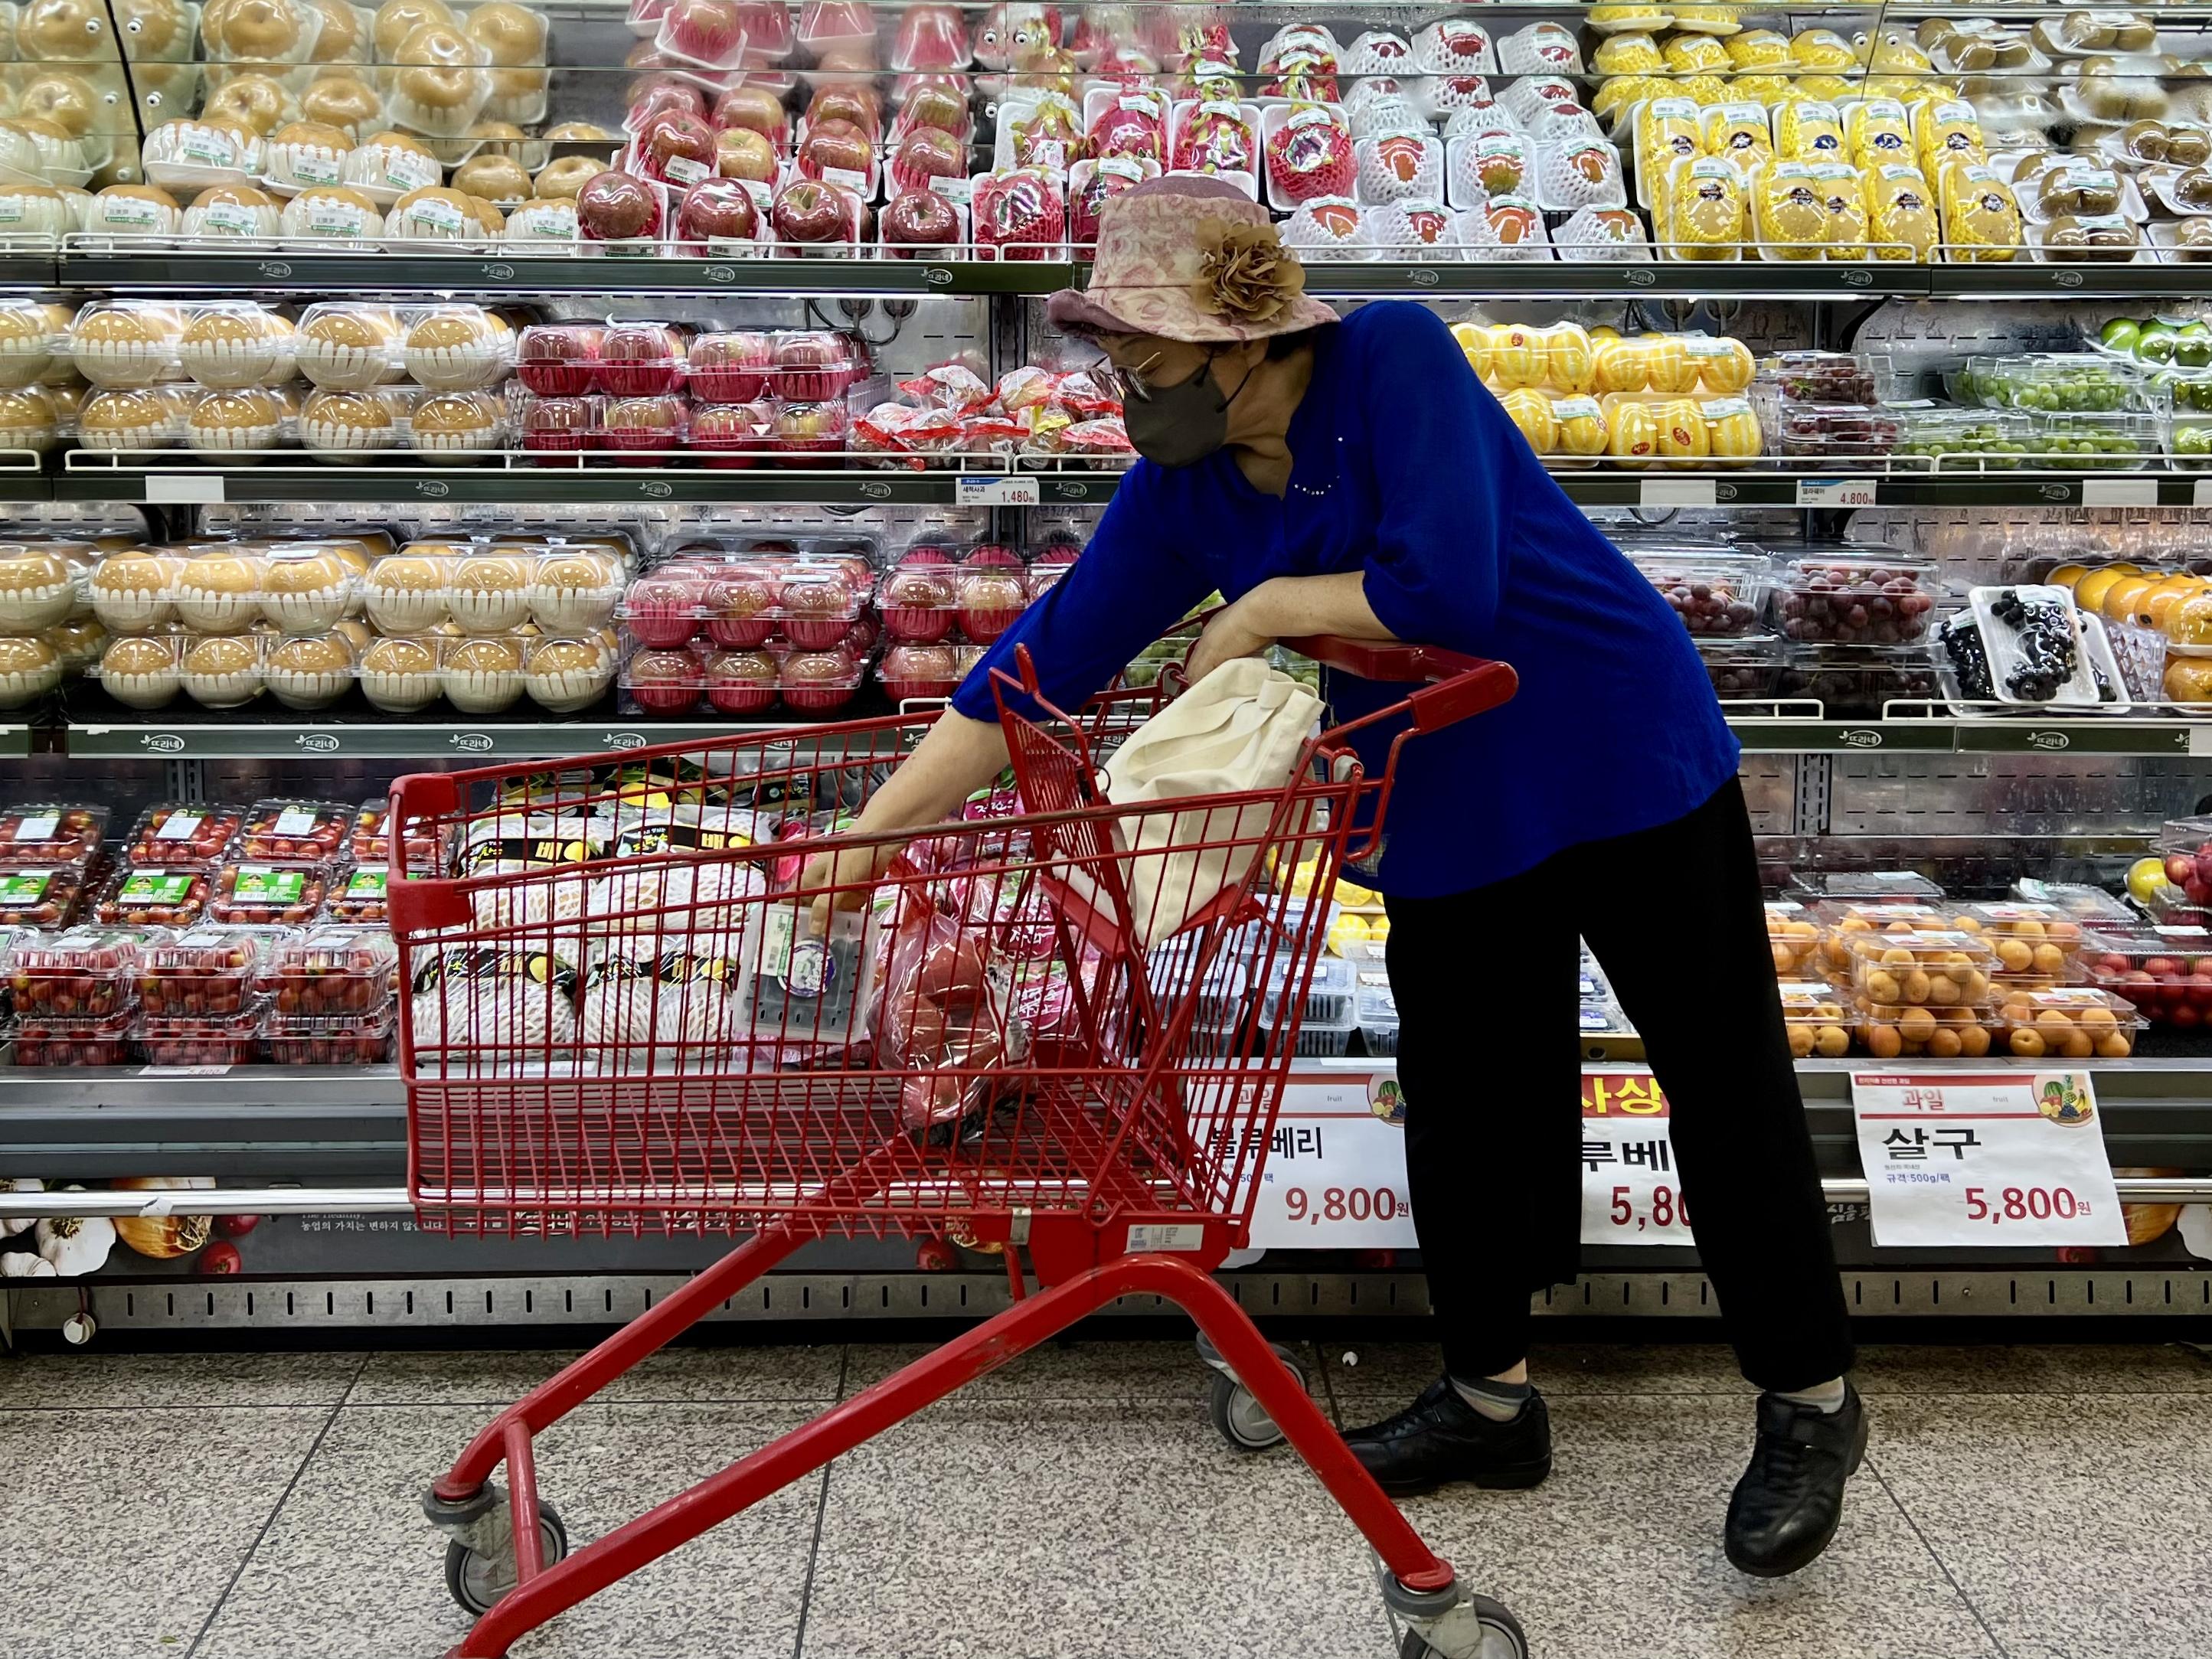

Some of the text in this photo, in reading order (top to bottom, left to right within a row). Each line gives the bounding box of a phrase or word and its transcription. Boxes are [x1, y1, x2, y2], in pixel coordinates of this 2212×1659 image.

[1903, 1089, 1945, 1110] 과일
[1882, 1128, 1982, 1160] 살구
[1886, 1173, 1950, 1184] 규격:500g/팩
[301, 1220, 331, 1231] 농업의
[335, 1220, 365, 1231] 가치는
[369, 1220, 398, 1231] 변하지
